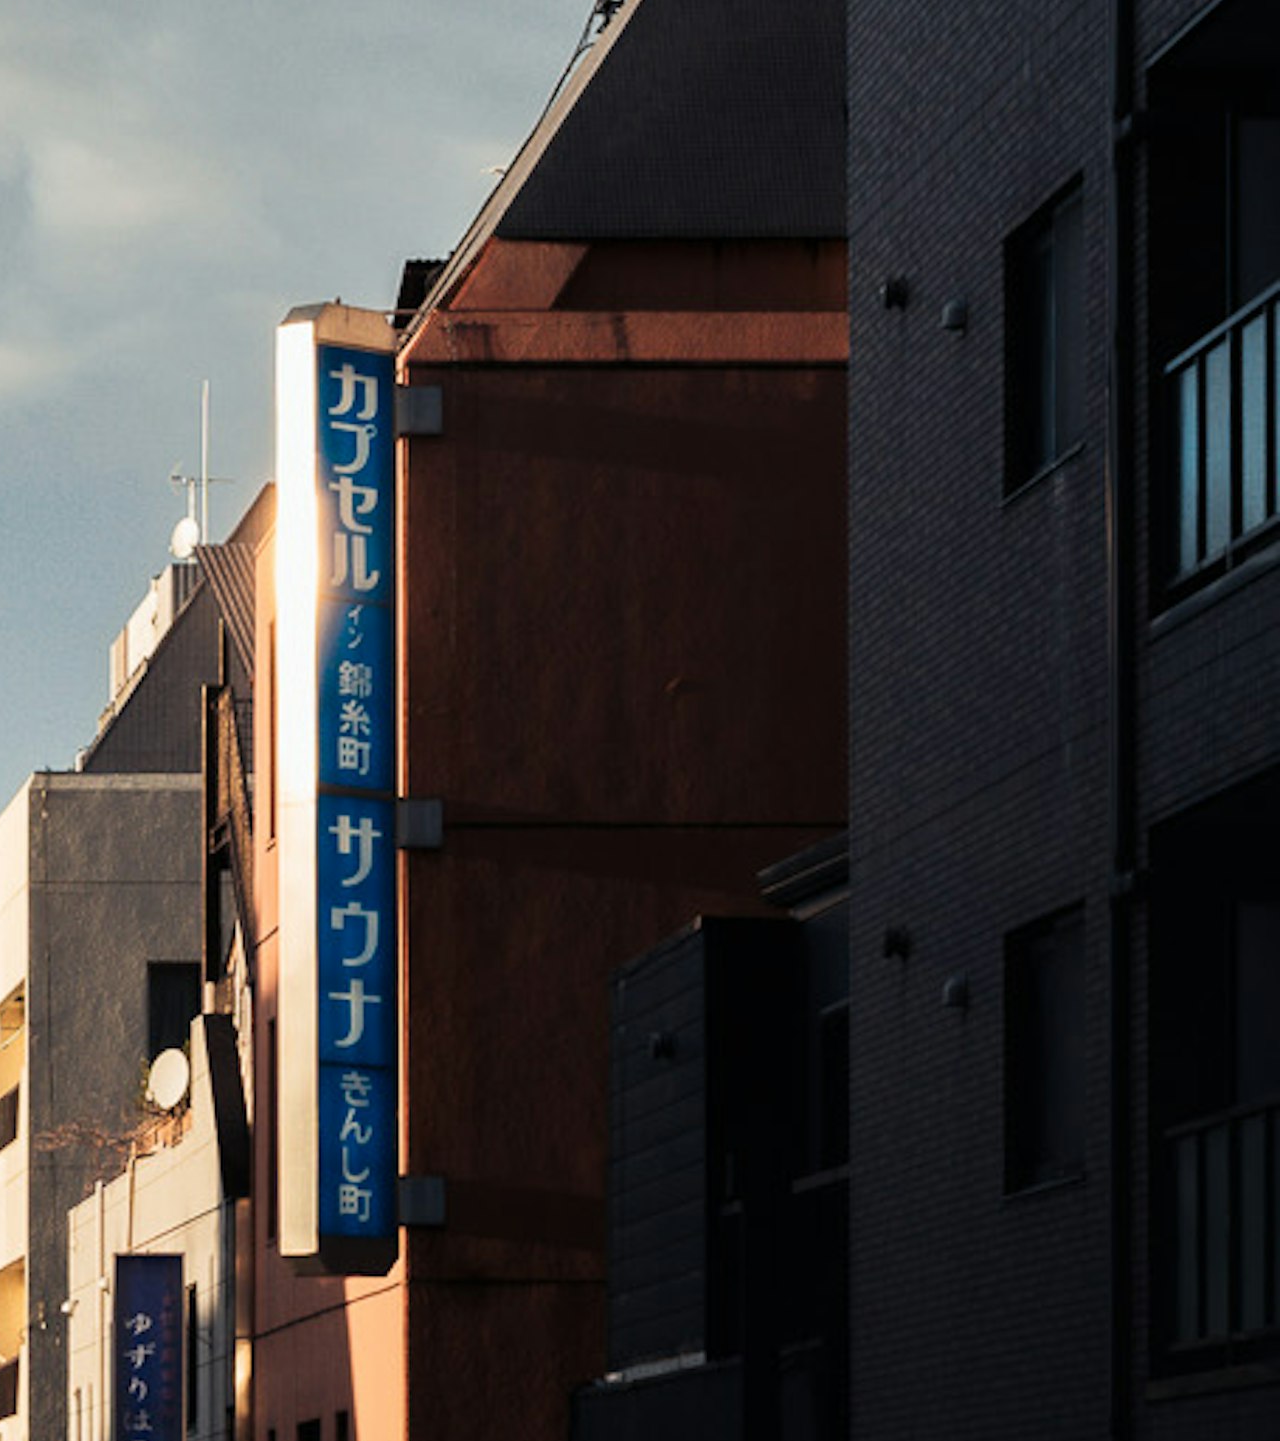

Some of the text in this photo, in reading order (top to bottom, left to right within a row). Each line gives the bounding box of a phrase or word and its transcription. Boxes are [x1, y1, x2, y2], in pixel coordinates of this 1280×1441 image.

[327, 362, 380, 593] カプセル
[327, 814, 383, 1050] サウナ
[337, 1071, 373, 1223] きんし町
